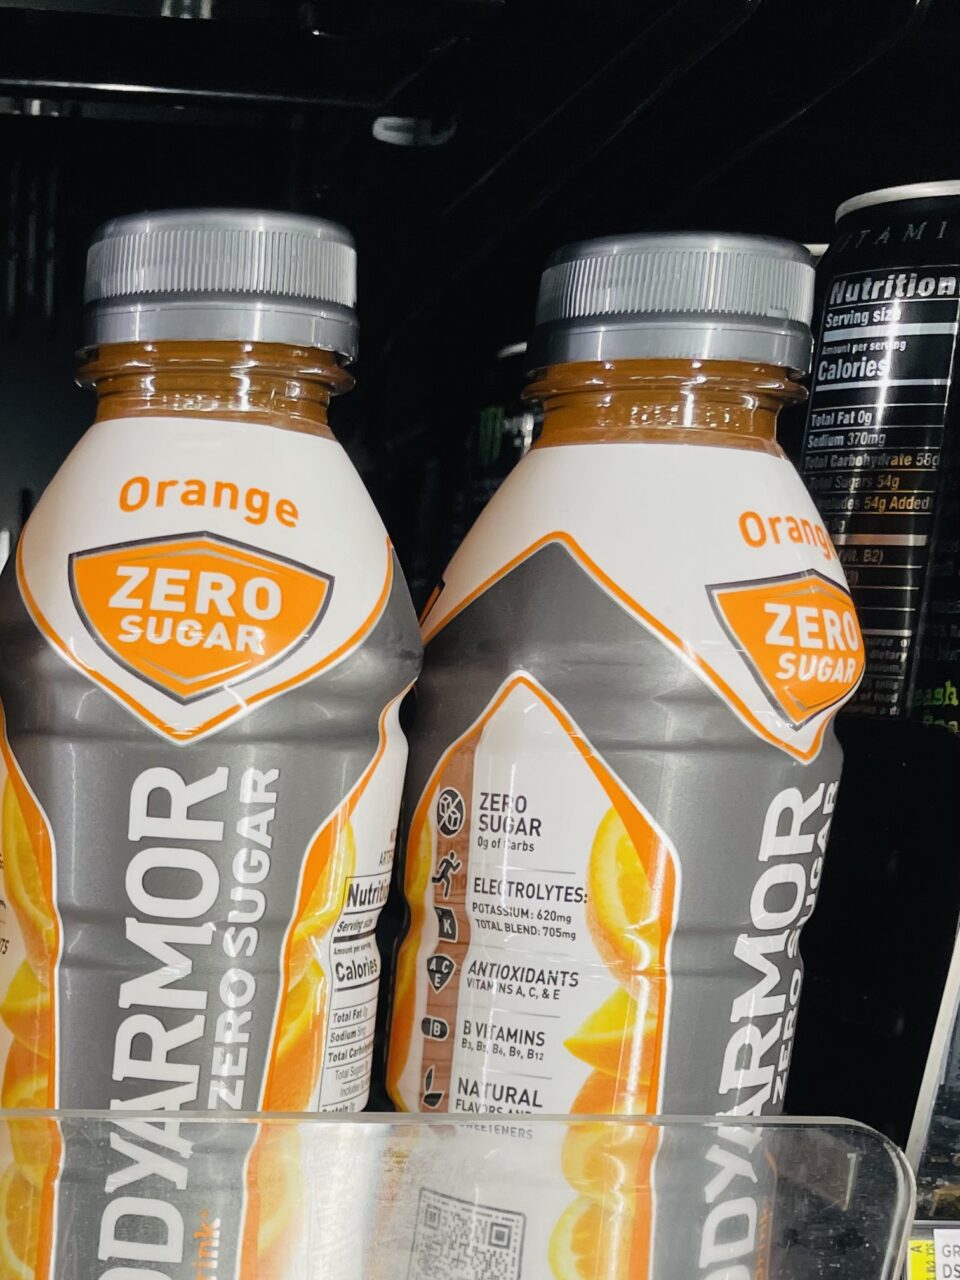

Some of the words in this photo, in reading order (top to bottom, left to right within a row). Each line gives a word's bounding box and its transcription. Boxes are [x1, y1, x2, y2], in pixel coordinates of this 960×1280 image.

[829, 273, 957, 305] Nutrition
[825, 310, 869, 328] Serving
[852, 343, 867, 354] per
[818, 356, 890, 381] Calories
[811, 412, 835, 427] Total
[837, 410, 855, 425] Fat
[857, 410, 873, 426] 0g
[807, 434, 844, 448] Sodium
[847, 432, 886, 447] 370mg
[805, 455, 828, 470] Total
[830, 452, 913, 469] Carbohydrate
[915, 452, 940, 469] 58g
[876, 474, 900, 491] 54g
[118, 475, 299, 528] Orange
[863, 496, 886, 513] 54g
[889, 495, 930, 511] Added
[108, 566, 282, 621] ZERO
[117, 615, 267, 656] SUGAR
[763, 602, 859, 652] ZERO
[775, 652, 856, 684] SUGAR
[479, 792, 528, 813] ZERO
[478, 814, 542, 837] SUGAR
[477, 836, 489, 850] 0g
[491, 836, 501, 848] of
[223, 767, 280, 958] SUGAR
[473, 877, 588, 904] ELECTROLYTES:
[337, 919, 363, 933] Serving
[536, 909, 572, 924] 620mg
[475, 919, 502, 932] TOTAL
[504, 923, 540, 936] BLEND:
[542, 927, 576, 942] 705mg
[335, 957, 378, 982] Calories
[467, 960, 580, 987] ANTIOXIDANTS
[515, 986, 526, 998] A,
[553, 989, 560, 1000] E
[332, 1010, 352, 1023] Total
[352, 1007, 363, 1020] Fat
[208, 968, 257, 1110] ZERO
[330, 1028, 357, 1043] Sodium
[463, 1020, 471, 1035] B
[476, 1022, 546, 1047] VITAMINS
[772, 968, 802, 1105] ZERO
[328, 1050, 348, 1063] Total
[527, 1049, 544, 1061] B12
[457, 1077, 543, 1108] NATURAL
